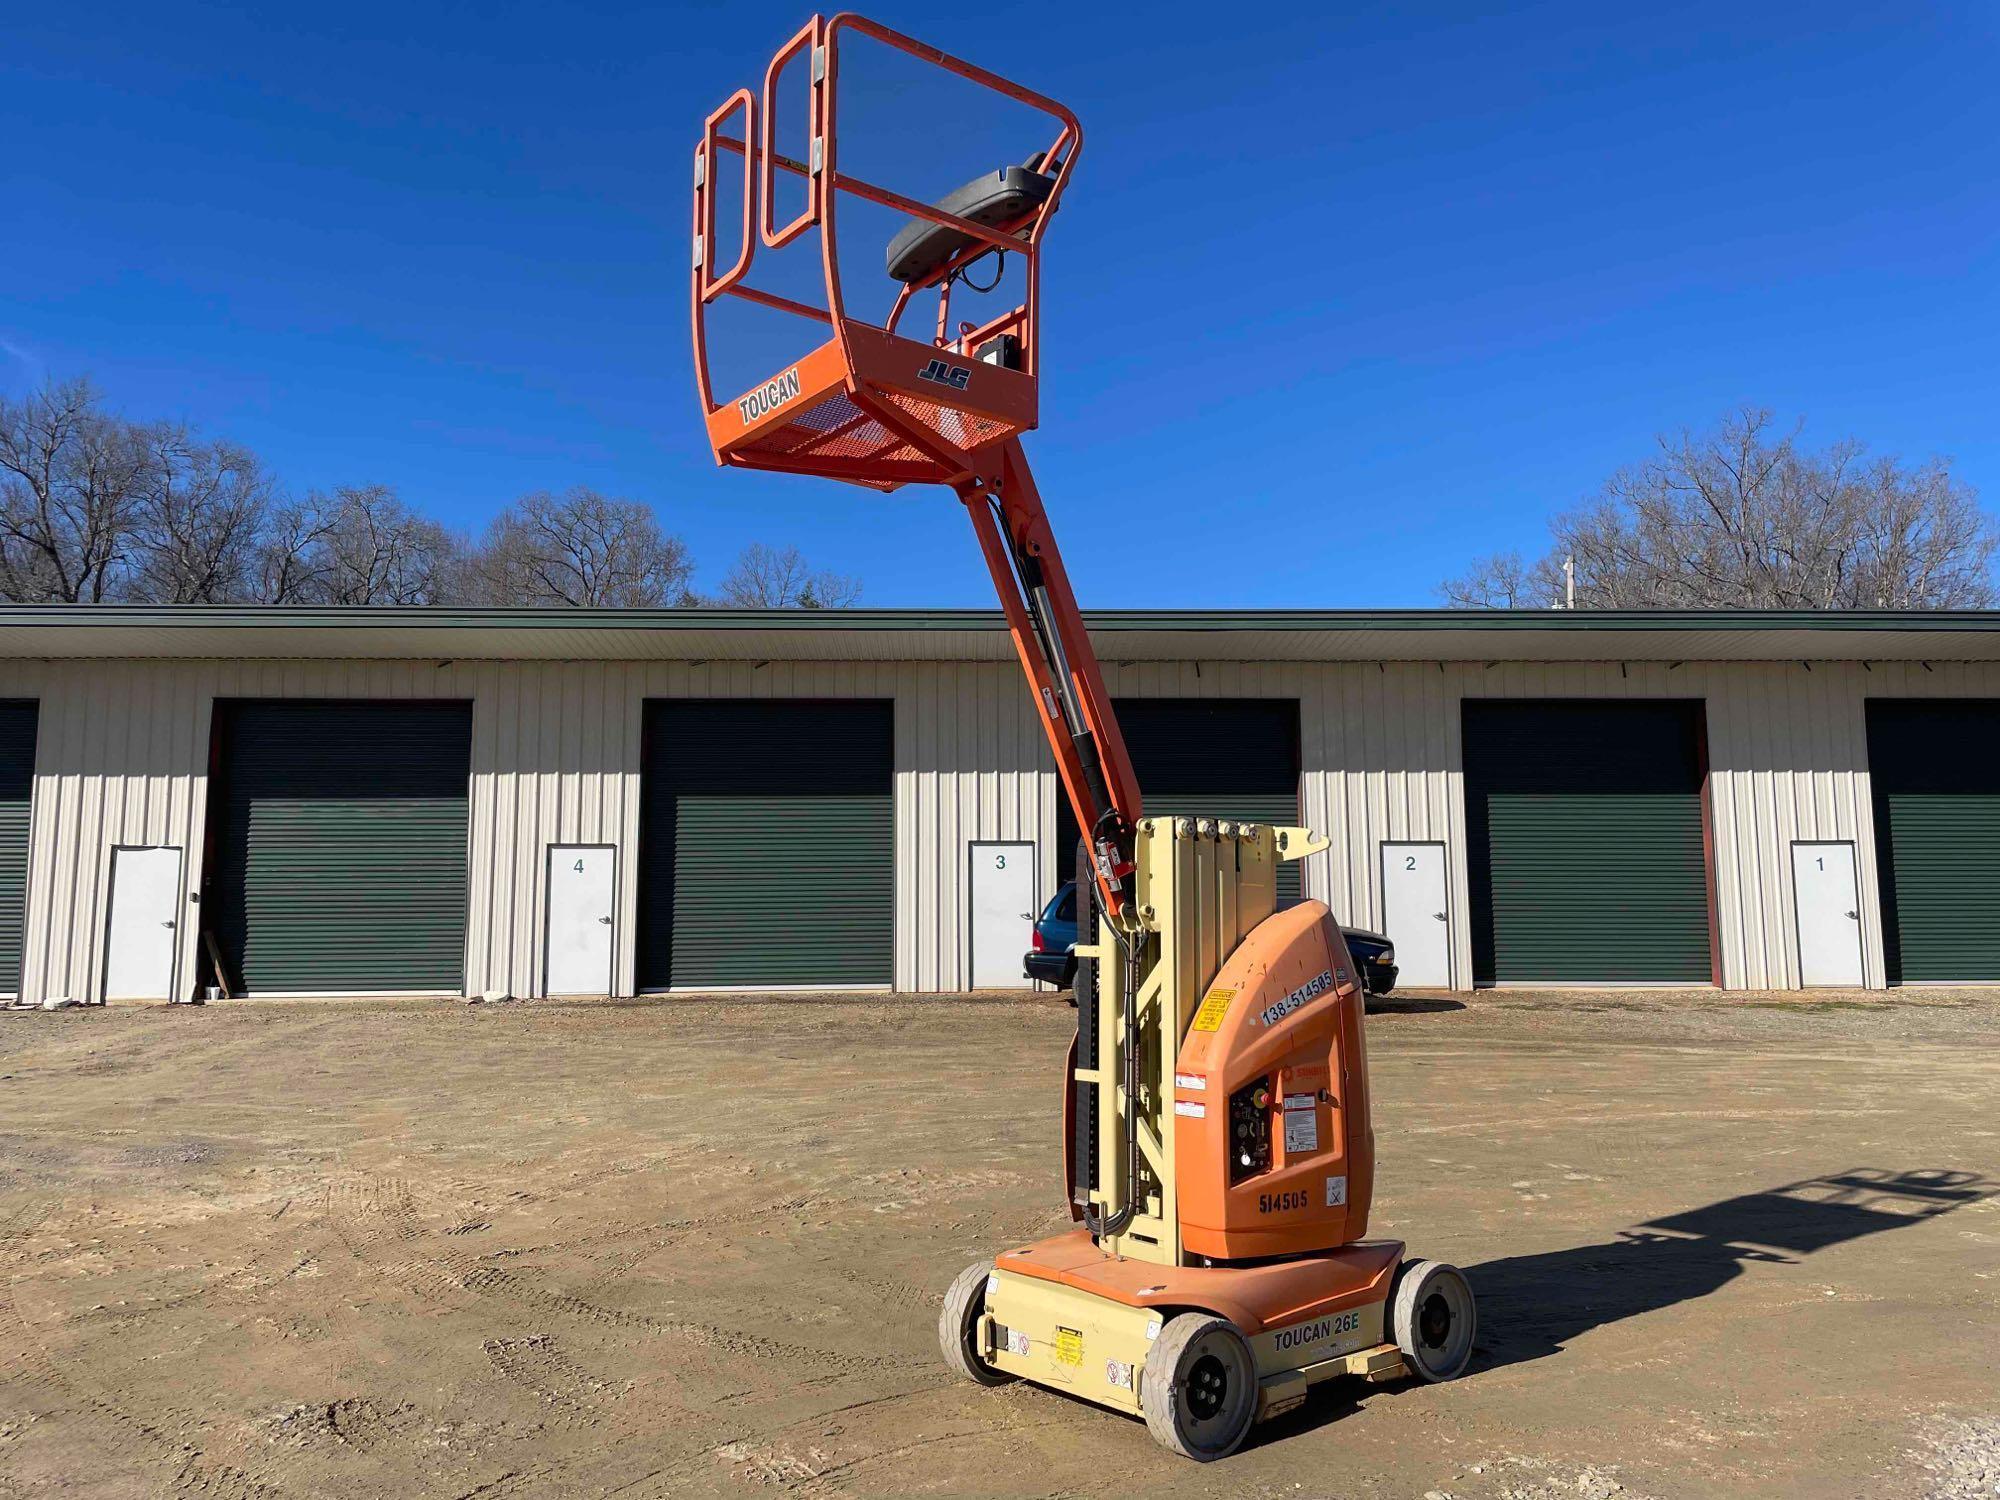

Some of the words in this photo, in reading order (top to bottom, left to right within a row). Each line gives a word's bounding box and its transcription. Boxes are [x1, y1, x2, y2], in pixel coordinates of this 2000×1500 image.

[918, 359, 971, 390] JLG
[740, 368, 800, 424] TOUCAN
[573, 858, 584, 873] 4
[995, 855, 1006, 870] 3
[1405, 856, 1416, 870] 2
[1815, 857, 1824, 871] 1
[1262, 971, 1332, 1025] 138-514505
[1259, 1190, 1308, 1213] 514505
[1274, 1321, 1331, 1351] TOUCAN
[1334, 1312, 1359, 1334] 26E
